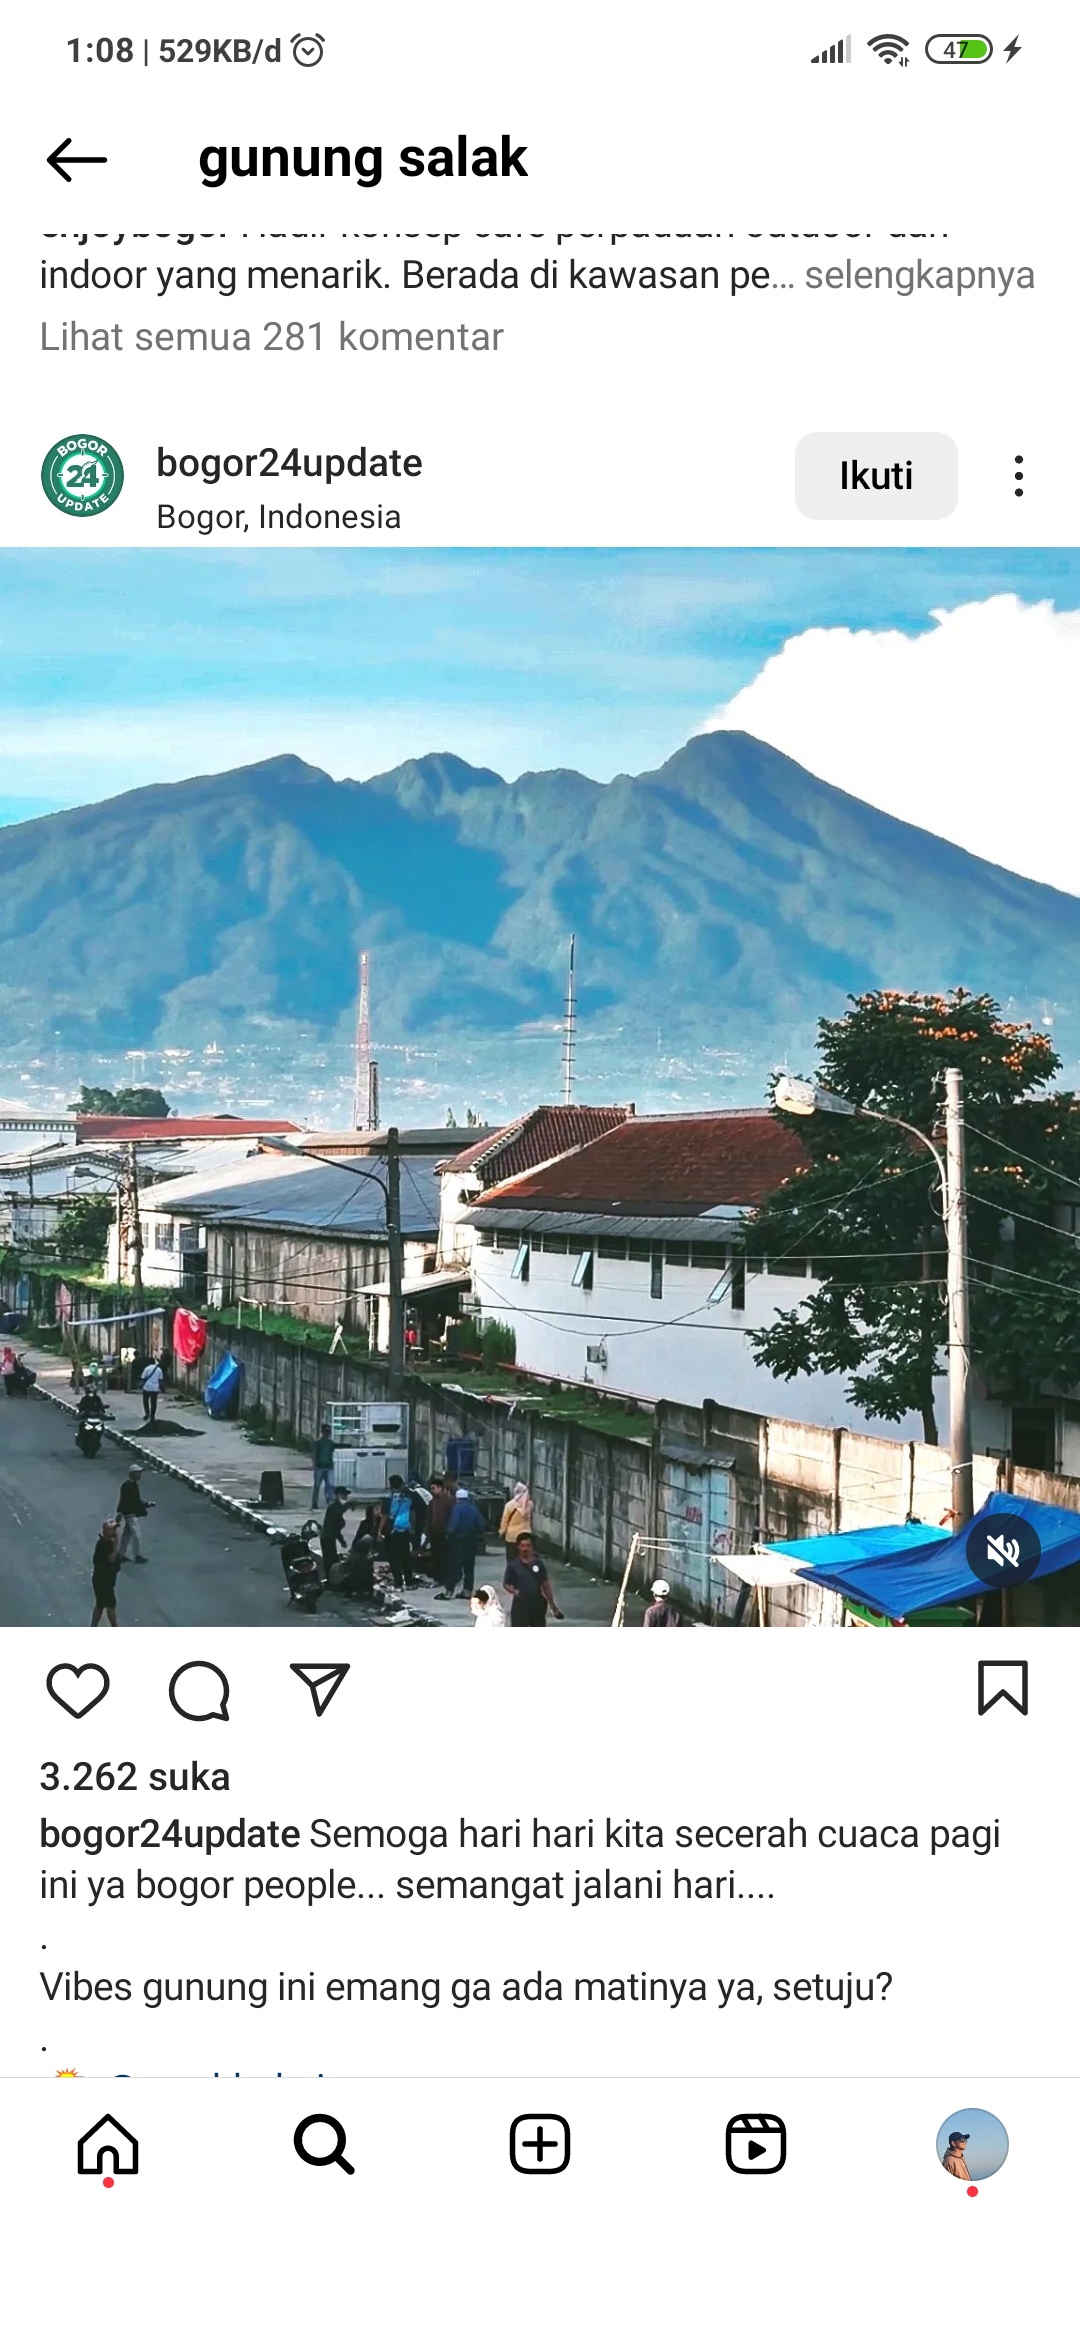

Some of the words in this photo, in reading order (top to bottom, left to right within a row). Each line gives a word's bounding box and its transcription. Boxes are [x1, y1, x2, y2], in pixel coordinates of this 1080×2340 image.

[68, 37, 133, 62] 1:08
[159, 37, 280, 64] 529KB/d
[943, 41, 969, 58] 47
[200, 146, 382, 188] gunung
[399, 135, 528, 177] salak
[42, 259, 147, 289] indoor
[157, 267, 235, 296] yang
[248, 259, 389, 289] menarik.
[404, 259, 518, 289] Berada
[531, 259, 557, 289] di
[570, 259, 718, 289] kawasan
[806, 259, 1034, 296] selengkapnya
[42, 321, 122, 350] Lihat
[136, 329, 250, 350] semua
[264, 322, 323, 350] 281
[341, 321, 504, 350] komentar
[57, 439, 108, 457] BOGOR
[66, 463, 99, 487] 24
[158, 447, 422, 484] bogor24update
[842, 459, 912, 490] Ikuti
[57, 493, 109, 511] UPDATE
[159, 504, 248, 535] Bogor,
[261, 503, 401, 529] Indonesia
[40, 1762, 137, 1791] 3.262
[149, 1761, 230, 1791] suka
[40, 1818, 300, 1855] bogor24update
[310, 1819, 447, 1855] Semoga
[460, 1818, 520, 1848] hari
[533, 1818, 593, 1848] hari
[606, 1818, 663, 1848] kita
[676, 1818, 806, 1848] secerah
[819, 1826, 918, 1848] cuaca
[931, 1819, 999, 1855] pagi
[42, 1870, 76, 1898] ini
[88, 1877, 124, 1907] ya
[137, 1869, 234, 1906] bogor
[245, 1869, 383, 1906] people...
[397, 1872, 564, 1906] semangat
[572, 1869, 661, 1906] jalani
[674, 1869, 773, 1899] hari....
[40, 1971, 131, 2001] Vibes
[144, 1979, 266, 2008] gunung
[280, 1972, 314, 2000] ini
[327, 1979, 439, 2008] emang
[452, 1979, 490, 2008] ga
[503, 1971, 562, 2001] ada
[575, 1972, 706, 2008] matinya
[718, 1979, 762, 2008] ya,
[774, 1972, 892, 2008] setuju?
